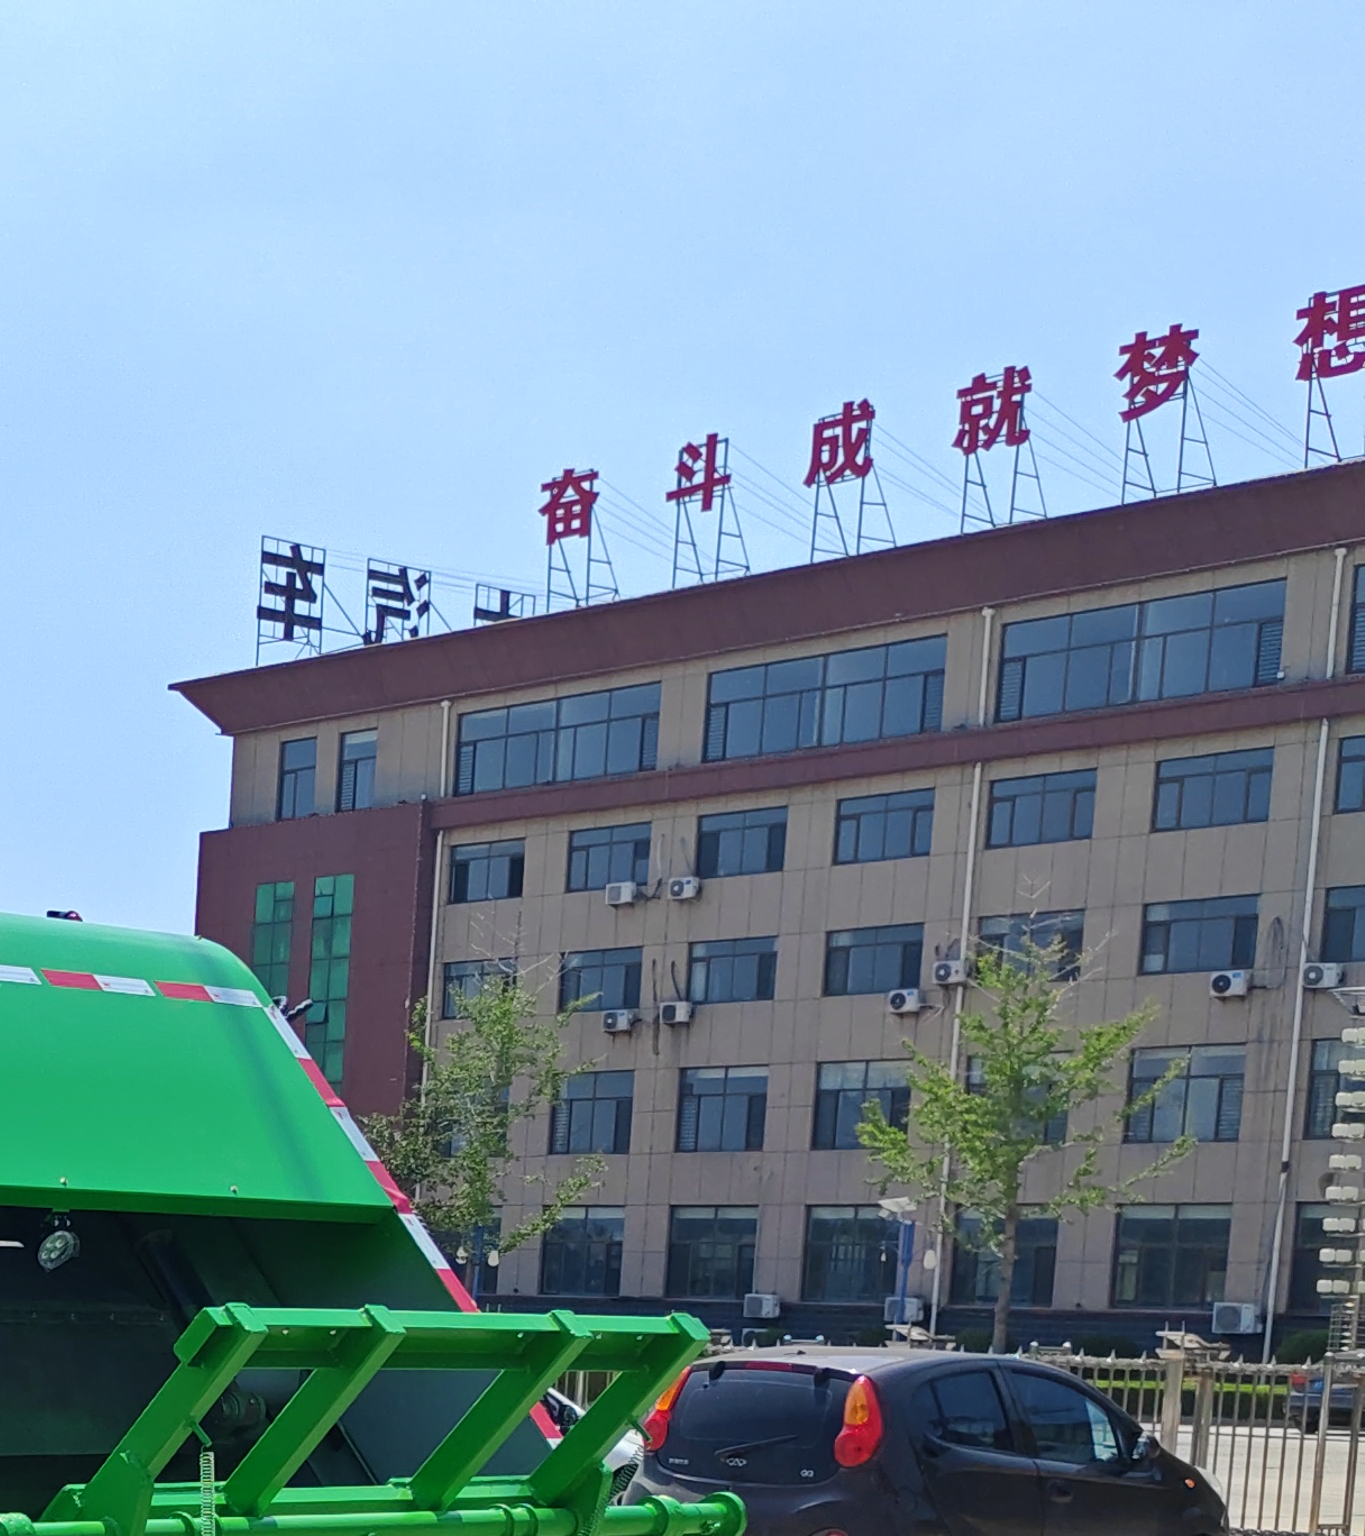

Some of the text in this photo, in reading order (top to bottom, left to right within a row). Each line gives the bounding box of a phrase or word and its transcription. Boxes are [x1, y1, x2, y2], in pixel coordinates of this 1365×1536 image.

[537, 283, 1365, 546] 奋斗成就梦想
